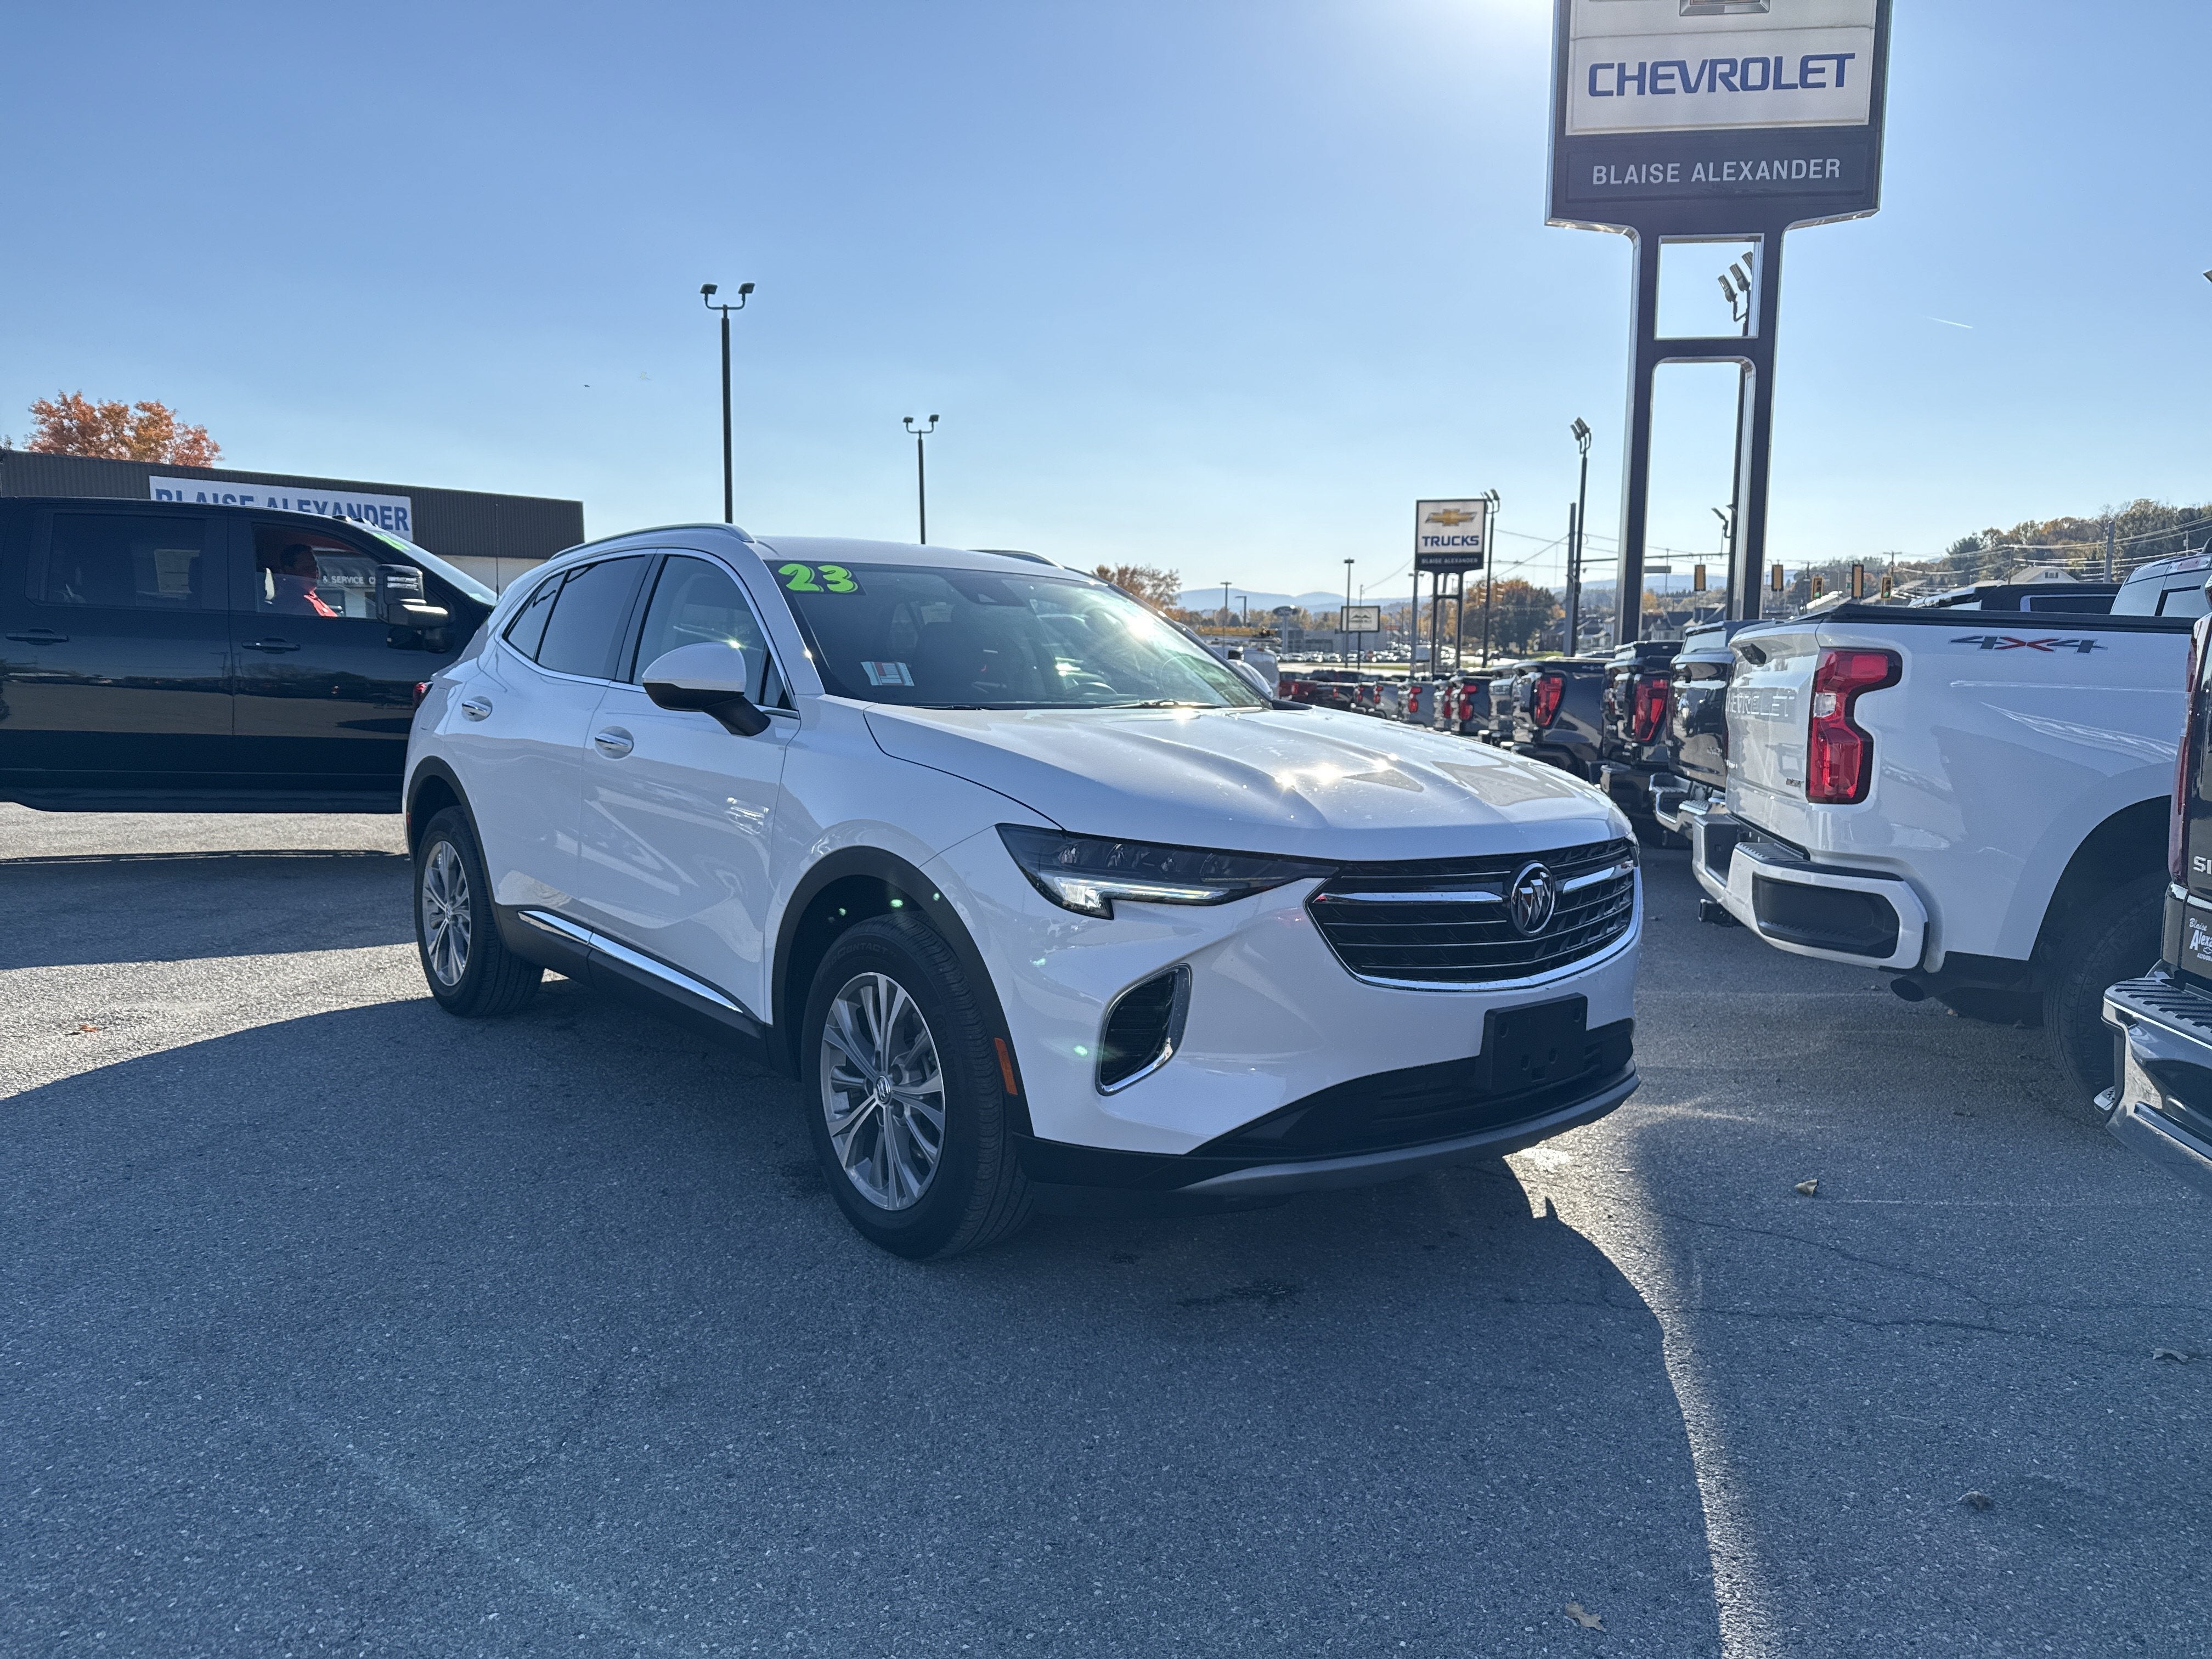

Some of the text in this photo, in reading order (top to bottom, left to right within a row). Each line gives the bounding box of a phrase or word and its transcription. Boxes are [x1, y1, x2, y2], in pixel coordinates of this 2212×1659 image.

[1588, 53, 1855, 97] CHEVROLET
[1592, 158, 1841, 185] BLAISE ALEXANDER
[1422, 535, 1480, 546] TRUCKS
[331, 575, 364, 584] SERVICE
[778, 563, 859, 593] 23
[2189, 917, 2208, 932] Blaise
